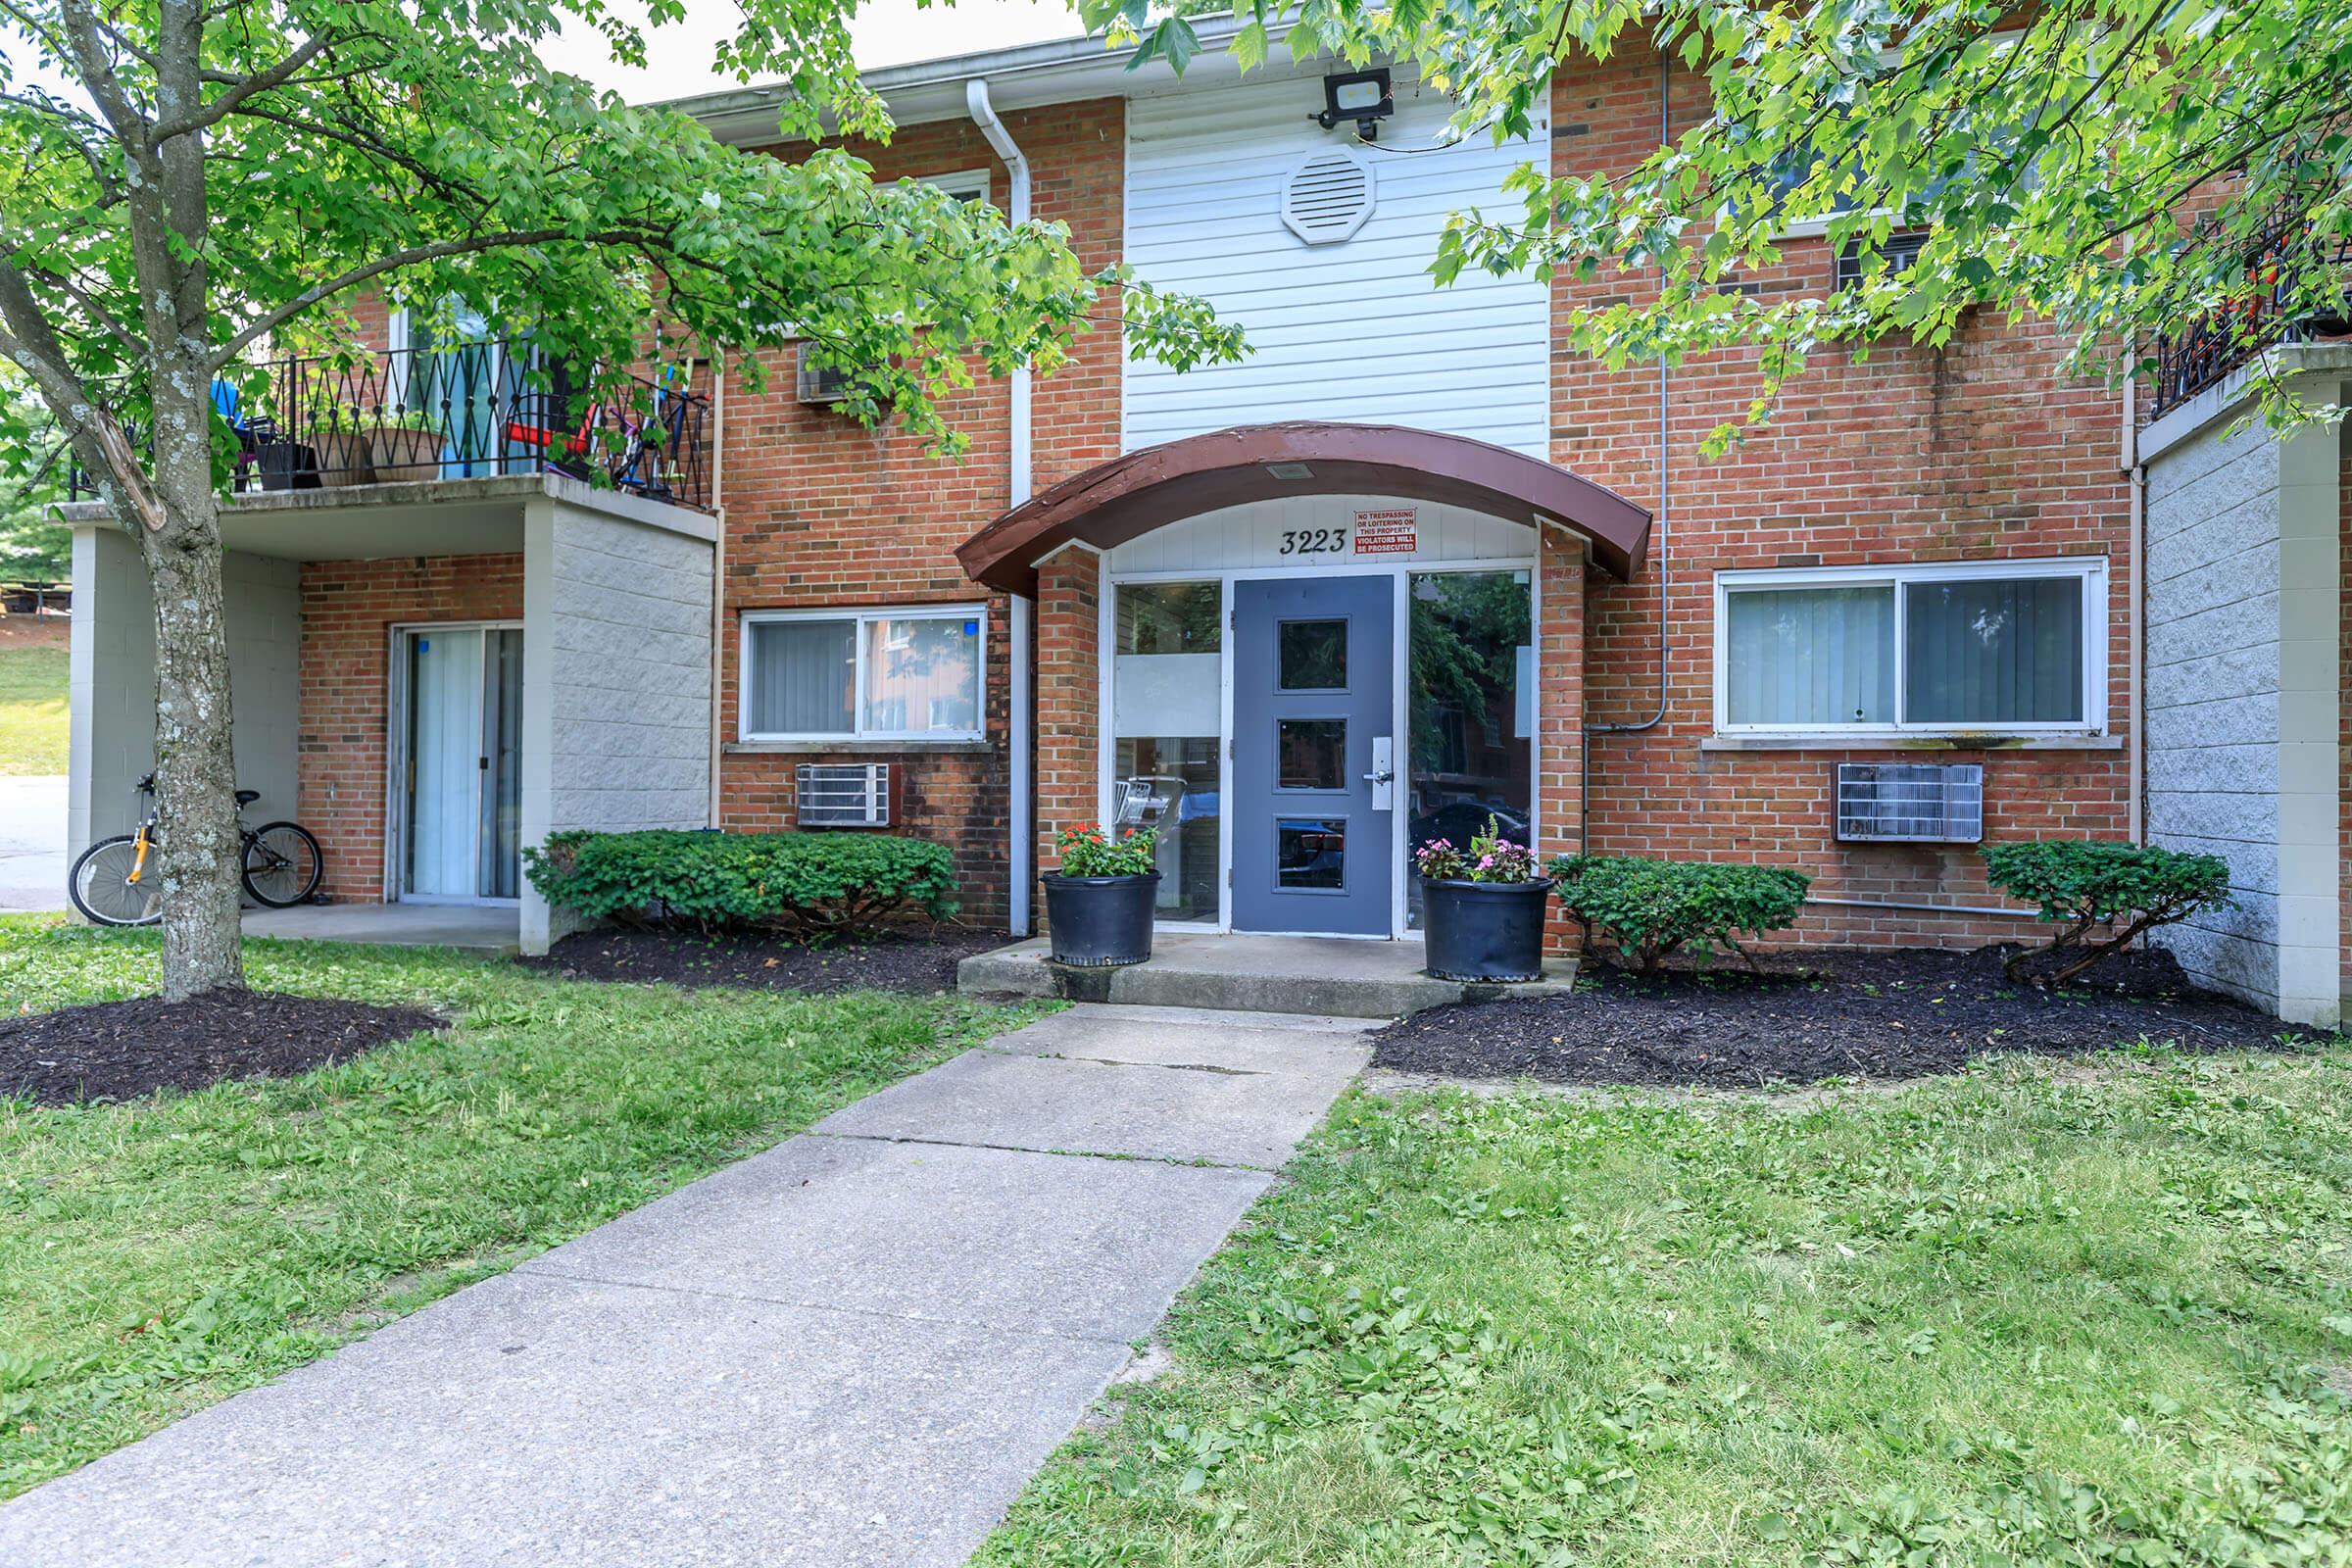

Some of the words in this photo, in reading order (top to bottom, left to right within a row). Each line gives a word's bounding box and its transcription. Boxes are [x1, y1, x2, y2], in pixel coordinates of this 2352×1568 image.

[1369, 511, 1413, 519] TRESPASSING
[1280, 528, 1348, 555] 3223
[1357, 536, 1396, 545] VIOLATORS
[1368, 543, 1414, 552] PROSECUTED
